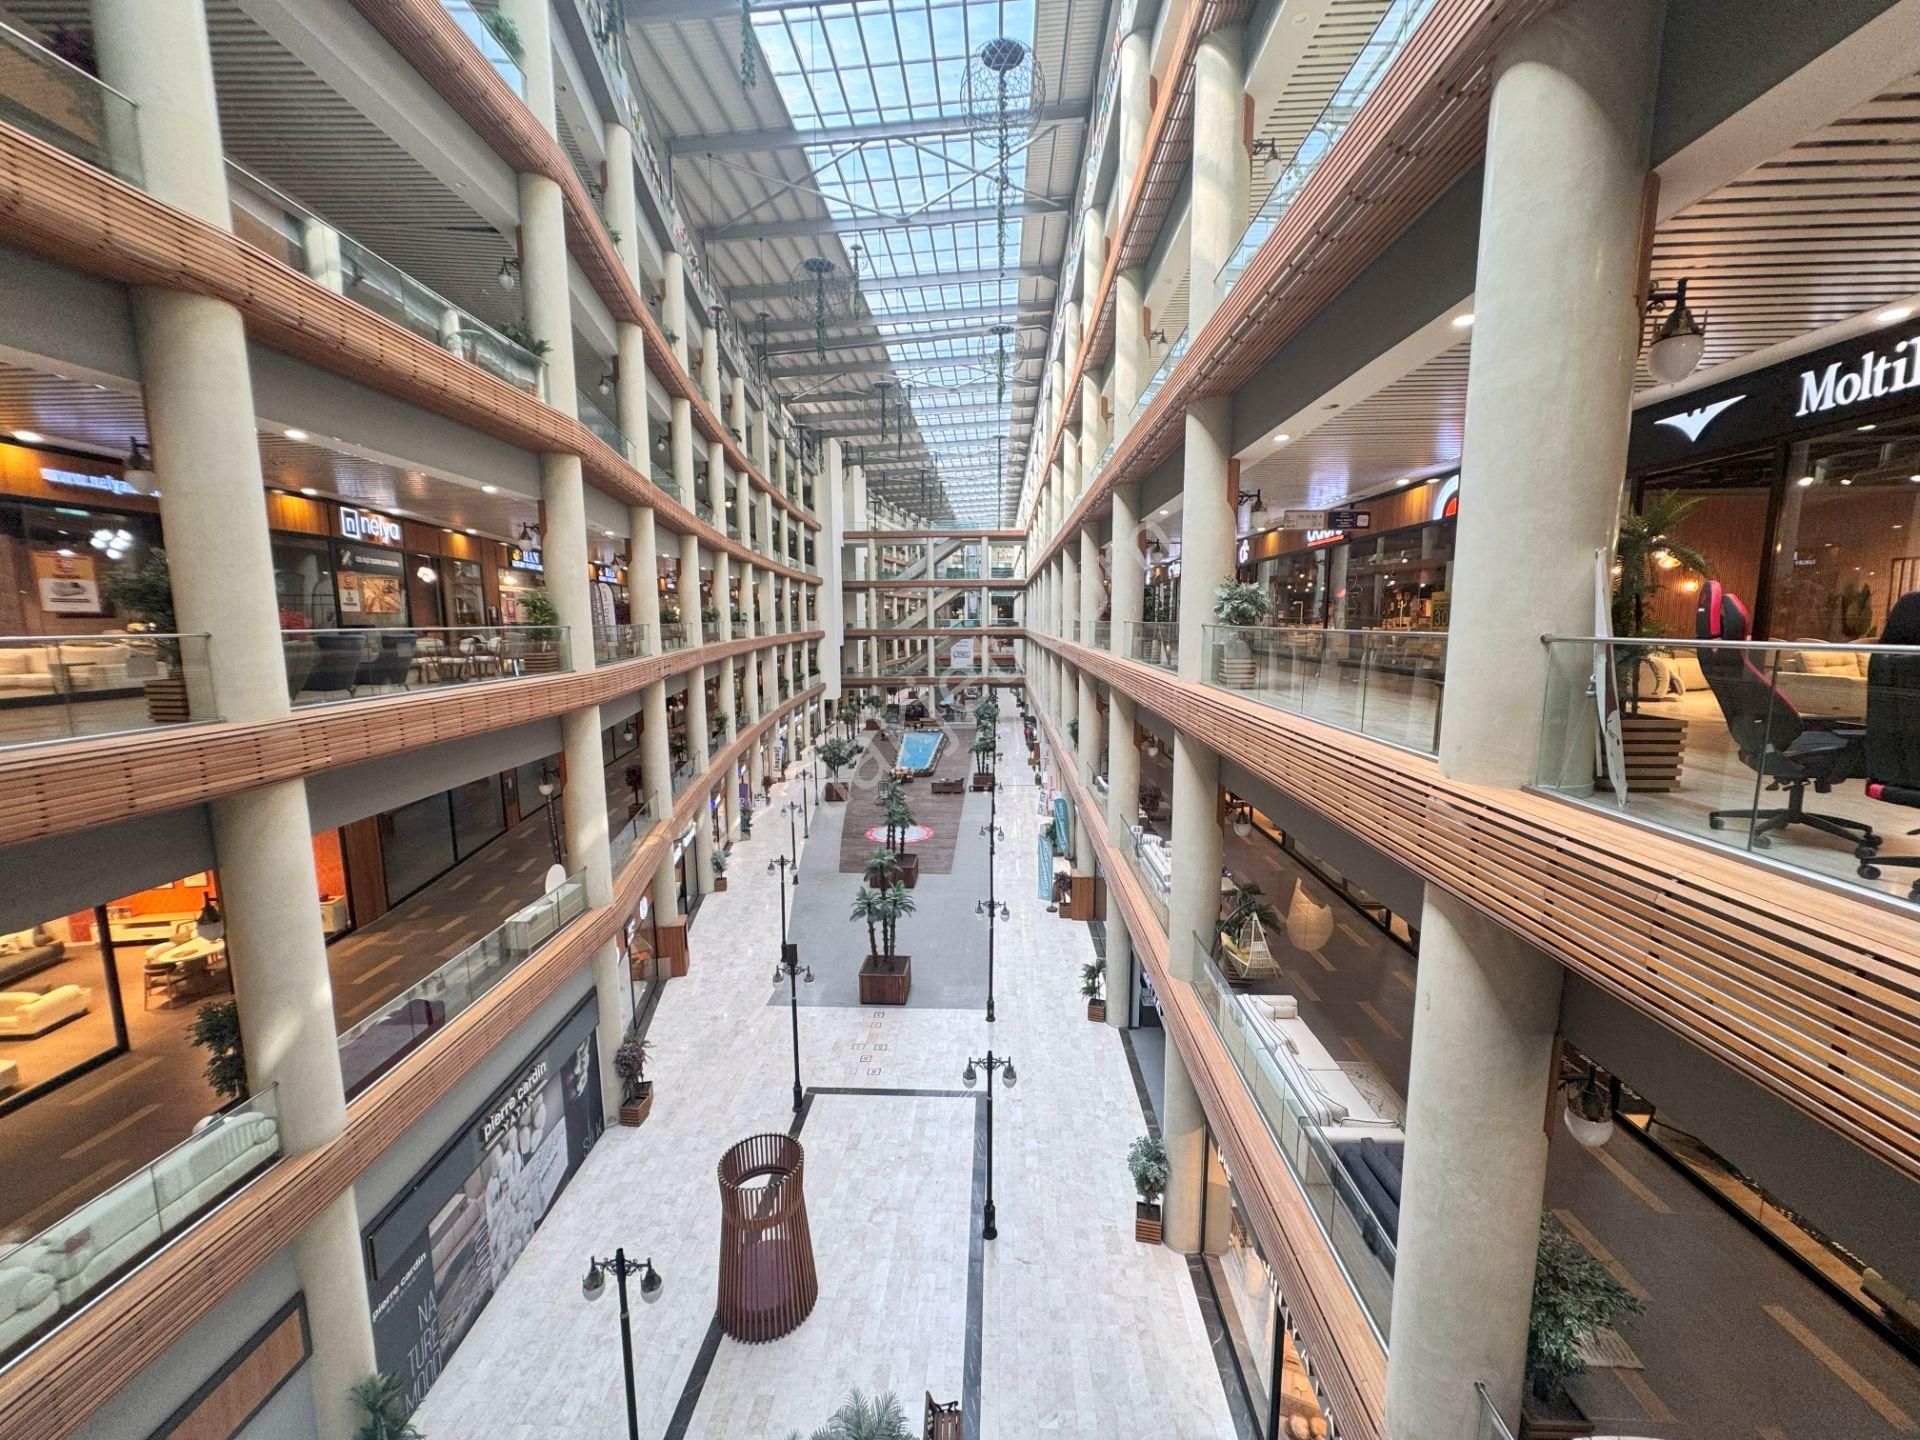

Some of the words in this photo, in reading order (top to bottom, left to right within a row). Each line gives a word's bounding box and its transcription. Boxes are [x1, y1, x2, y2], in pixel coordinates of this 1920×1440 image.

[360, 516, 401, 544] nelya
[484, 1097, 516, 1142] pierre
[517, 1062, 547, 1100] cardin
[503, 1093, 534, 1131] YATAK
[372, 1285, 399, 1323] pierre
[400, 1252, 427, 1287] cardin
[418, 1289, 437, 1330] NA
[407, 1316, 440, 1377] TURE
[404, 1348, 442, 1415] MOOD
